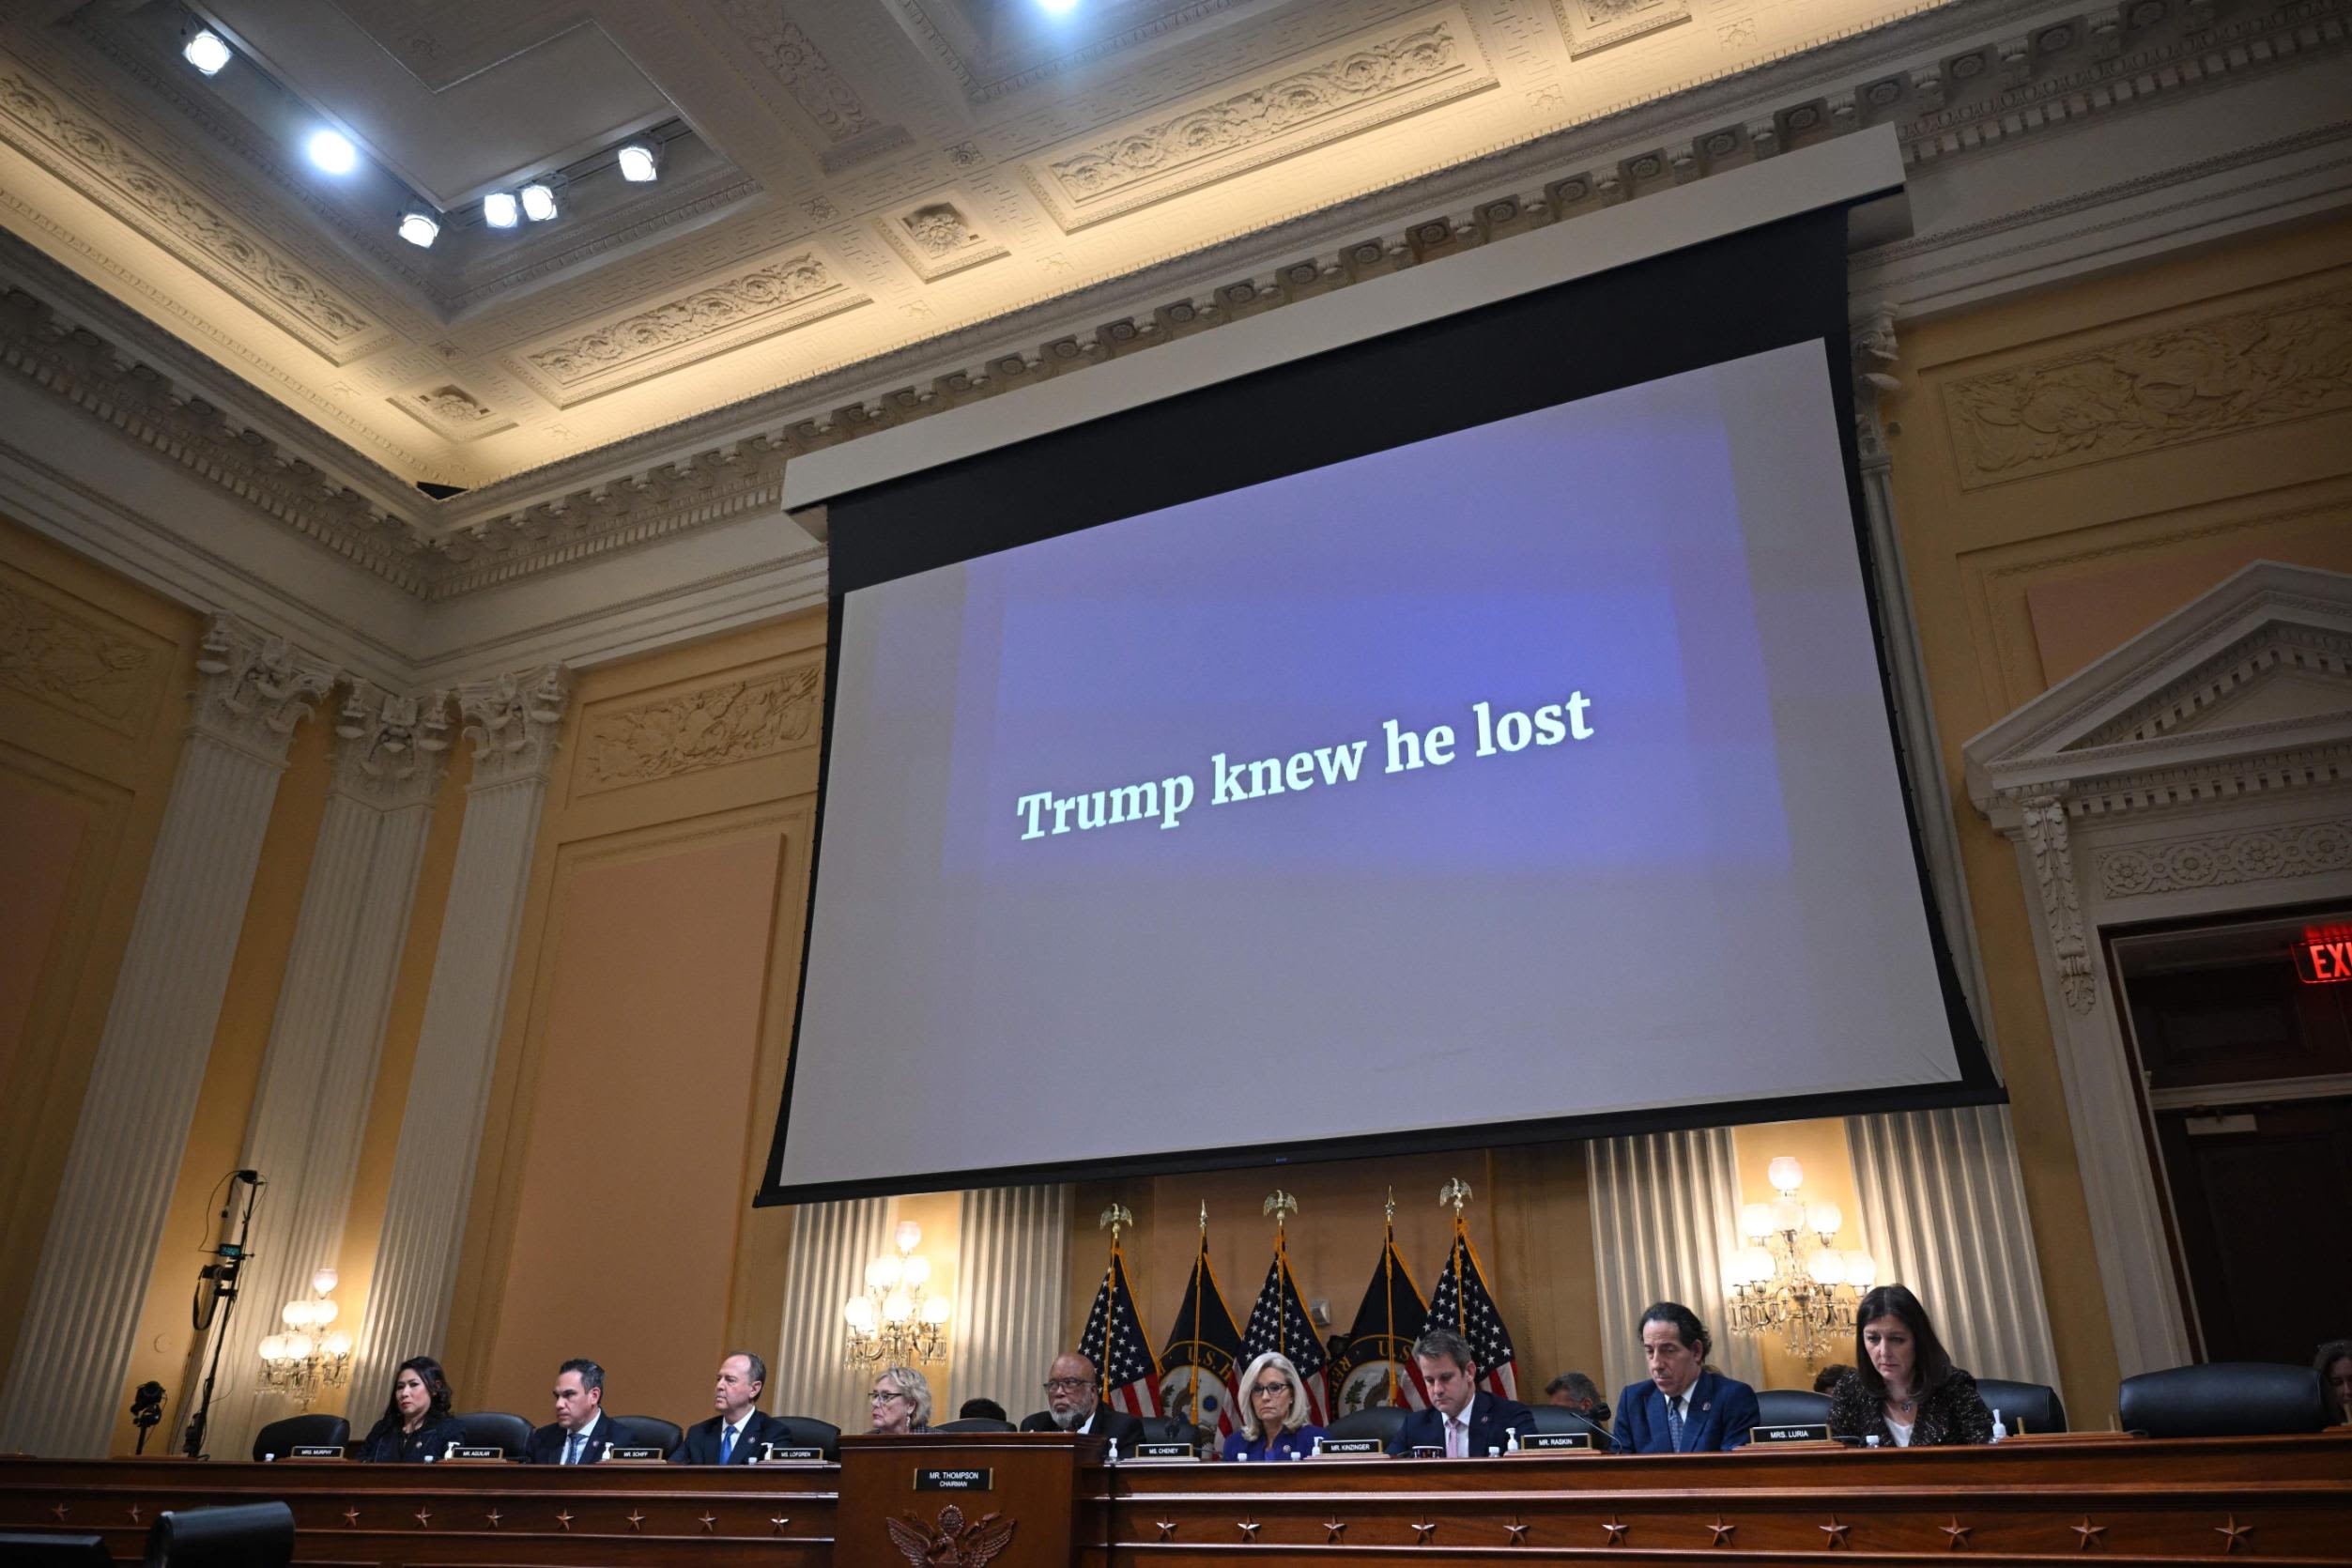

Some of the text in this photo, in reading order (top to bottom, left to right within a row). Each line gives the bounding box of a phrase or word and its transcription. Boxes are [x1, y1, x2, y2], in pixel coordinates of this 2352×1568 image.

[1016, 690, 1594, 840] Trump knew he lost
[1788, 1430, 1809, 1438] LURIA
[929, 1471, 979, 1480] MR. THOMPSON
[939, 1480, 968, 1488] CHAIRMAN
